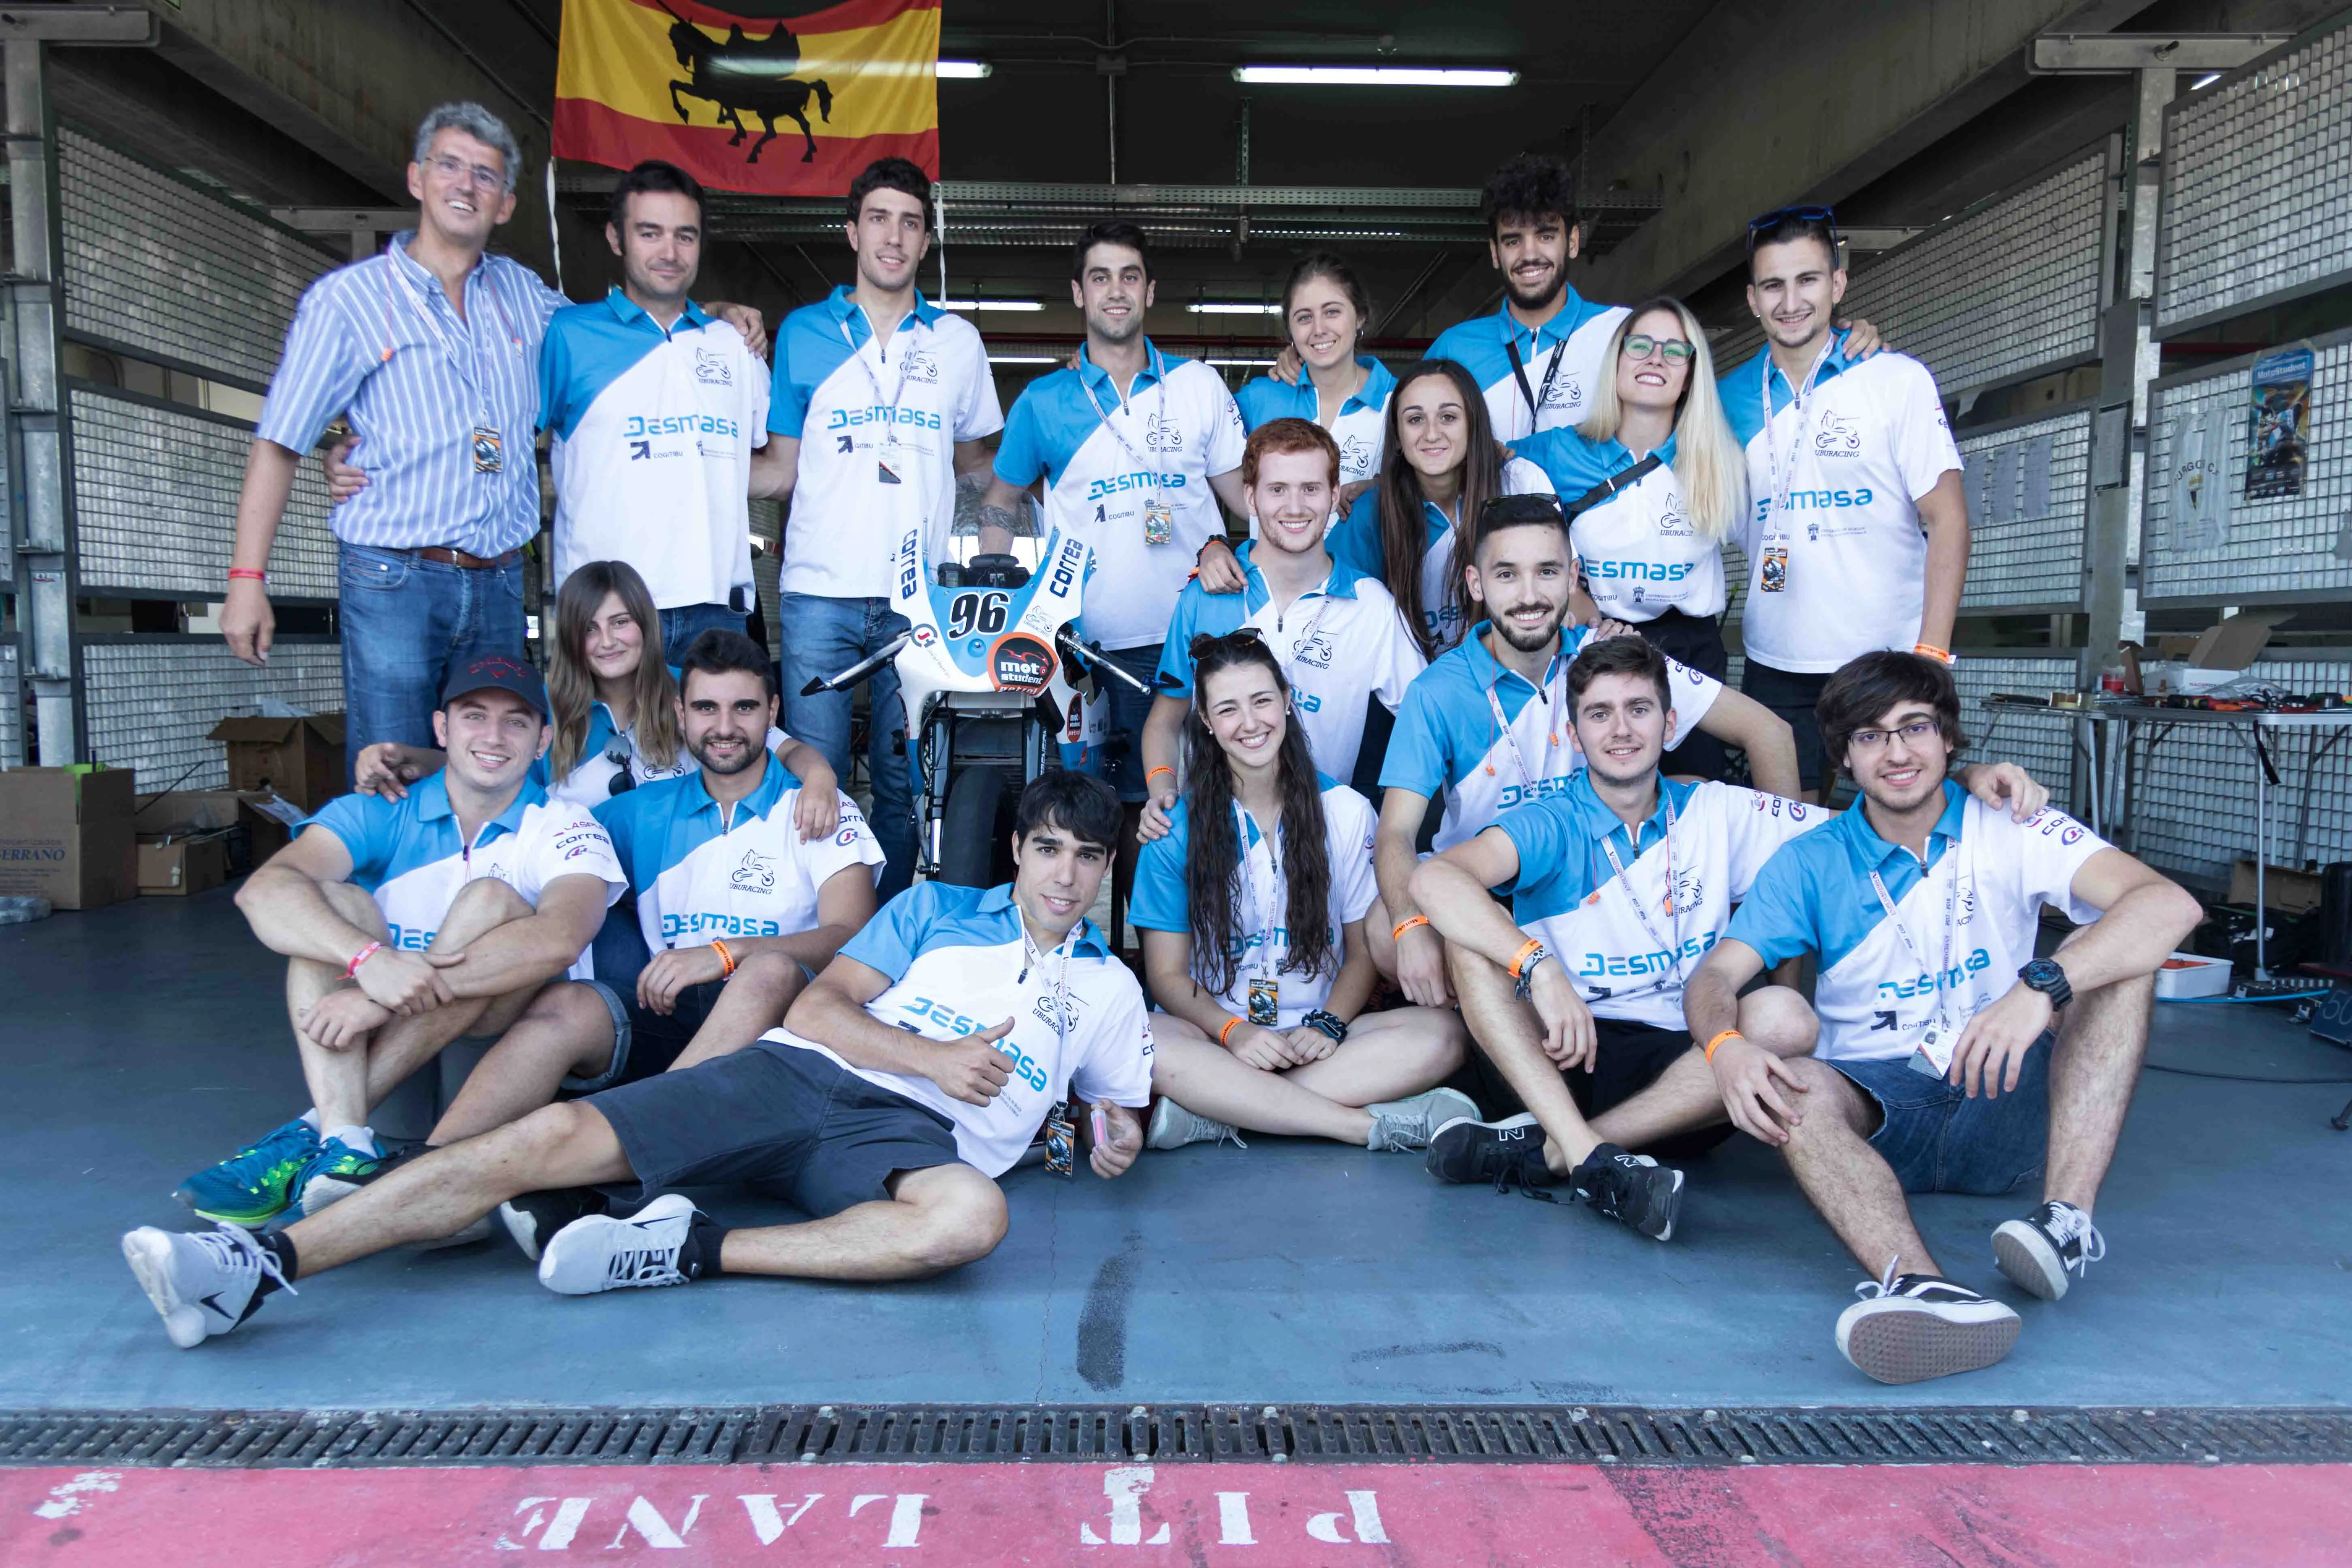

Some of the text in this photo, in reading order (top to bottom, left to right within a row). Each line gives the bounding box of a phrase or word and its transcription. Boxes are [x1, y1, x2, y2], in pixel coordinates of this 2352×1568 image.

[2257, 362, 2307, 379] MotoStudent
[1108, 511, 1135, 520] COGITIBU
[901, 529, 918, 600] correa
[1049, 538, 1084, 598] correa
[948, 592, 1011, 641] 96
[1001, 661, 1048, 676] moto
[1001, 673, 1044, 685] student
[556, 833, 610, 849] correa
[730, 883, 773, 895] UBURACING
[493, 1466, 1392, 1551] PIT LANE
